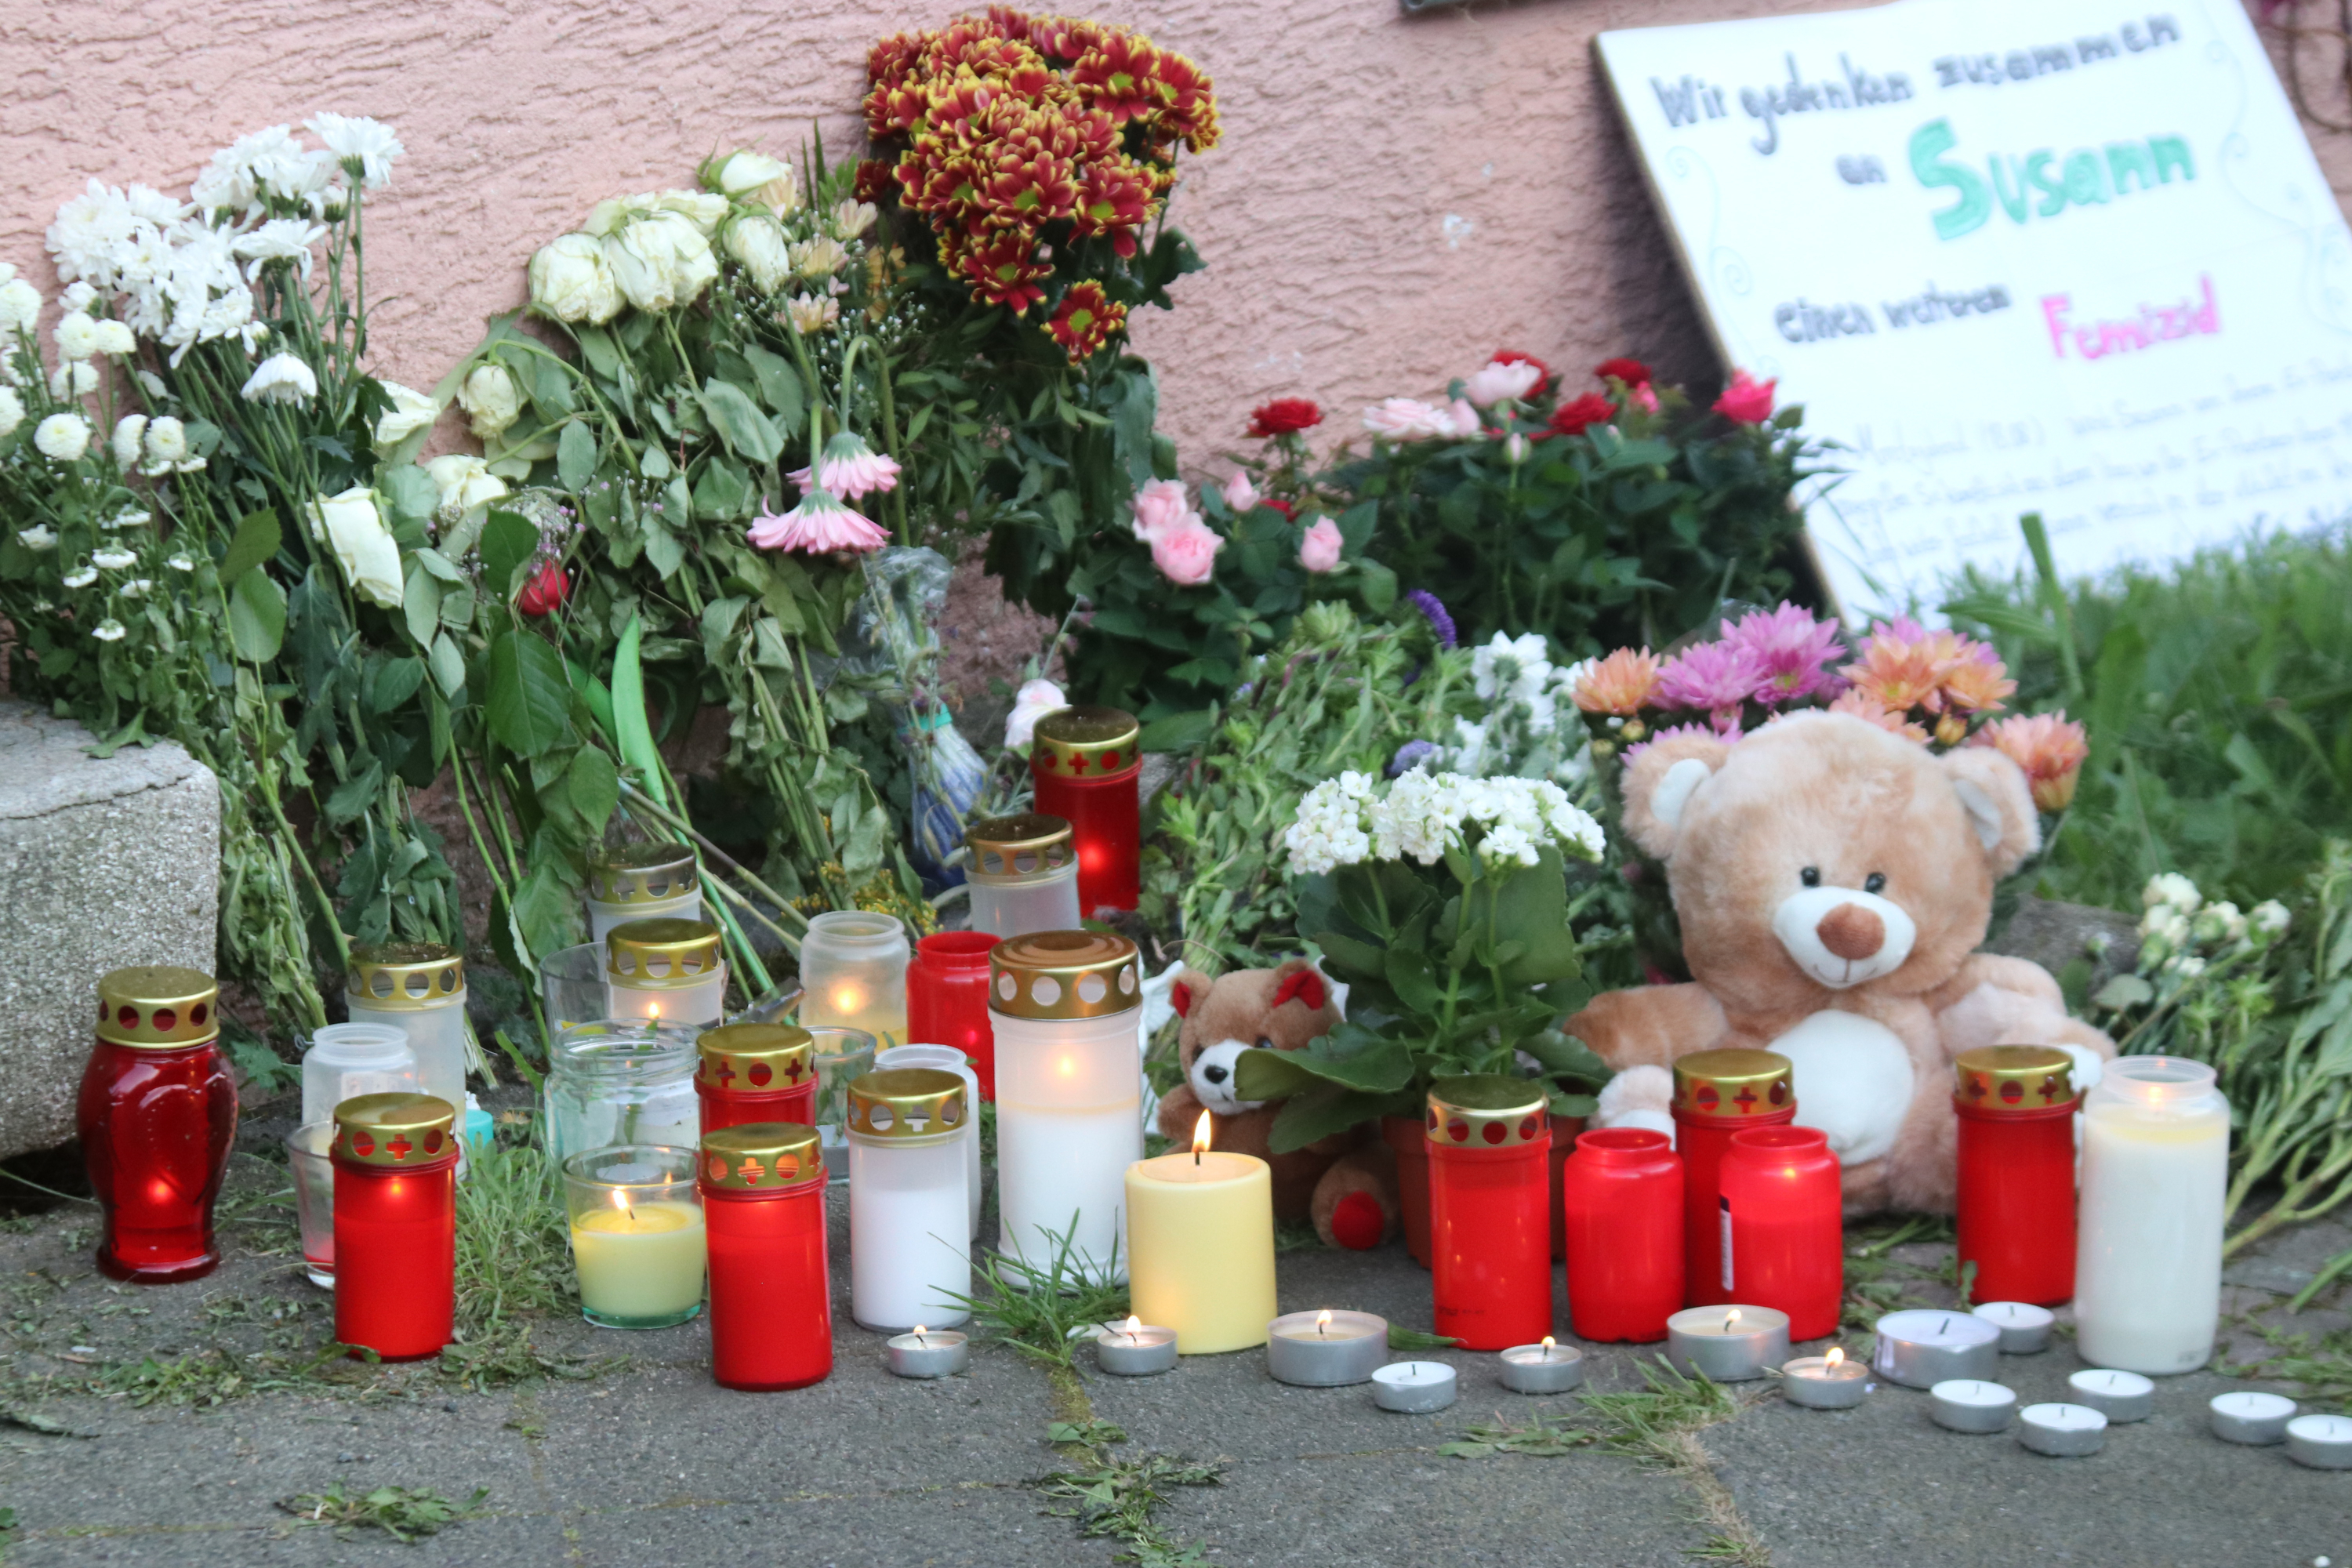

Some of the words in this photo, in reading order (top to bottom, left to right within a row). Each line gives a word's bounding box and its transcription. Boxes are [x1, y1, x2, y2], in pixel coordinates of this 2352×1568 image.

[1648, 74, 1729, 127] Wir
[1738, 52, 1914, 155] gedenken
[1933, 13, 2181, 88] zusammen
[1908, 115, 2196, 241] Susann
[2039, 272, 2221, 360] Femizid
